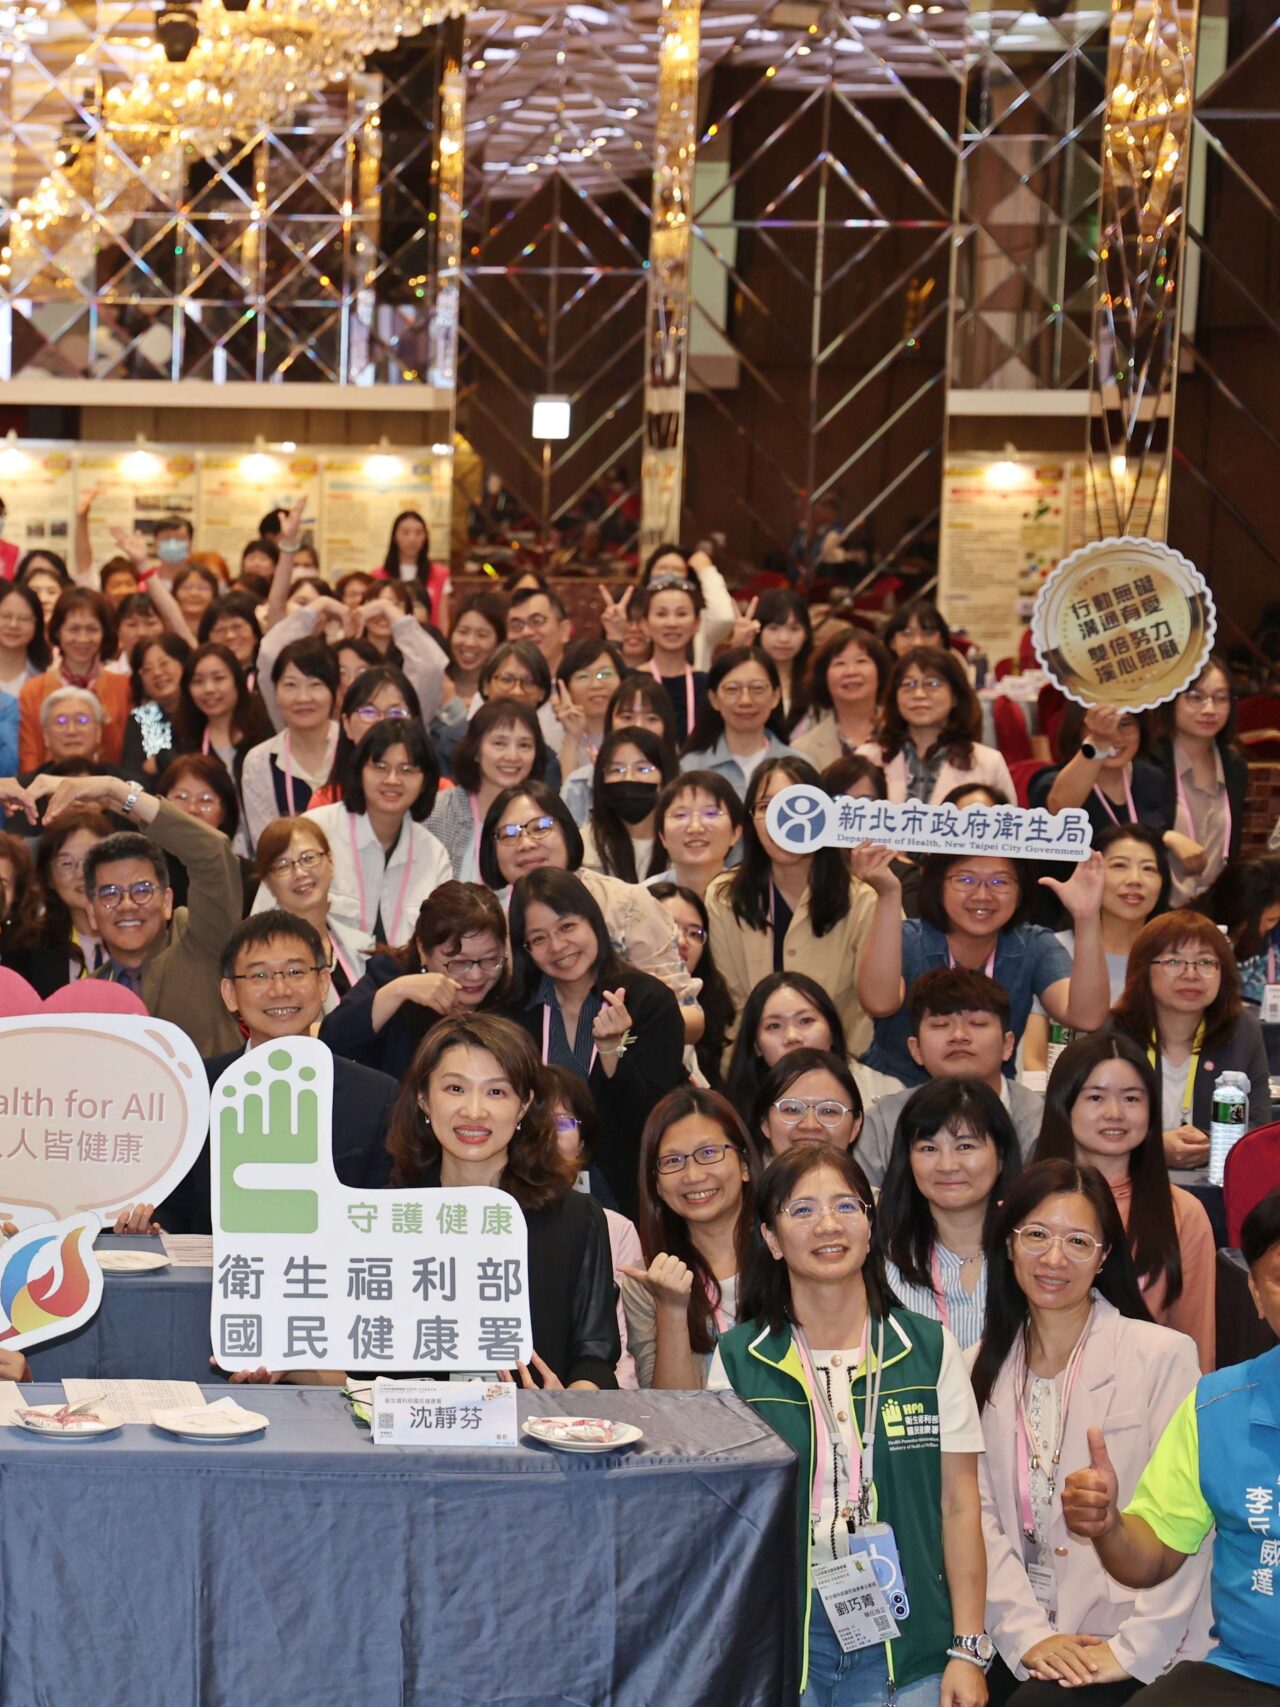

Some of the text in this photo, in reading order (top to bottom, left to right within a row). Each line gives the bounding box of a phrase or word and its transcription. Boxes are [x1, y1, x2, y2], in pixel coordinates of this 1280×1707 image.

[1078, 594, 1163, 641] 溝通有愛
[1088, 620, 1173, 664] 雙倍努力
[838, 802, 1086, 844] 新北市政府衛生局
[894, 837, 905, 845] of
[907, 838, 942, 849] Health,
[944, 840, 967, 848] New
[969, 842, 999, 852] Taipei
[1001, 844, 1023, 854] City
[1025, 846, 1085, 856] Government
[65, 1089, 114, 1120] for
[121, 1092, 165, 1122] All
[347, 1201, 513, 1235] 守護健康
[218, 1254, 523, 1302] 衛生福利部
[220, 1314, 524, 1362] 國民健康署
[409, 1405, 483, 1430] 沈靜芬
[902, 1402, 924, 1415] HPA
[834, 1593, 876, 1617] 劉巧菁
